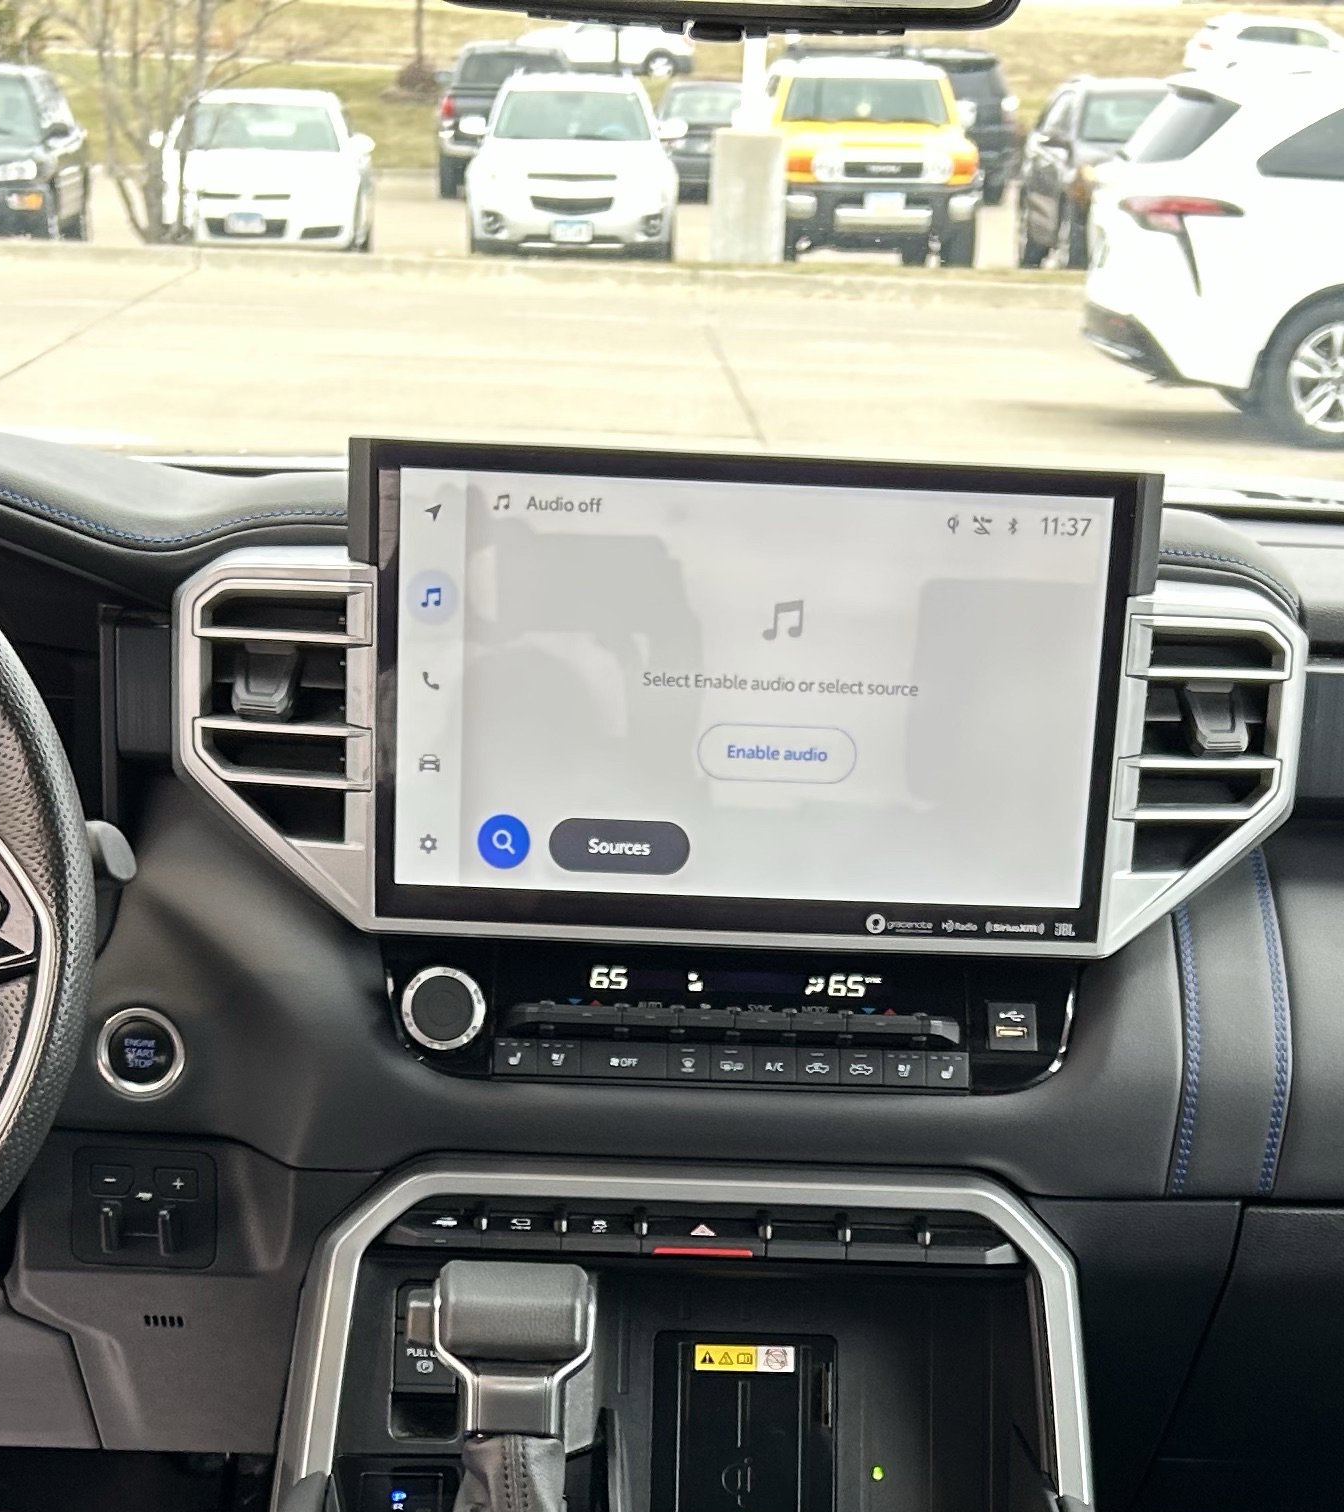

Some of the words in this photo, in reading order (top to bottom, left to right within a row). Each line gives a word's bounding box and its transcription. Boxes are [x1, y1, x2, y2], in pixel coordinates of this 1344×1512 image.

[526, 496, 574, 512] Audio
[578, 497, 603, 513] off
[1040, 516, 1092, 537] 11:37
[642, 671, 690, 689] Select
[694, 673, 748, 691] Enable
[750, 675, 796, 693] audio
[798, 680, 815, 693] or
[817, 678, 864, 696] select
[867, 683, 920, 697] source
[726, 744, 780, 761] Enable
[783, 746, 828, 762] audio
[587, 837, 652, 856] Sources
[887, 920, 934, 931] gracenote
[1054, 921, 1076, 937] JBL
[588, 965, 629, 990] 65
[827, 973, 866, 998] 65
[124, 1038, 156, 1048] ENGINE
[125, 1047, 155, 1058] START
[127, 1059, 154, 1069] STOP
[619, 1057, 639, 1067] OFF
[764, 1061, 784, 1072] A/C
[406, 1347, 429, 1358] PULL
[393, 1502, 404, 1511] R
